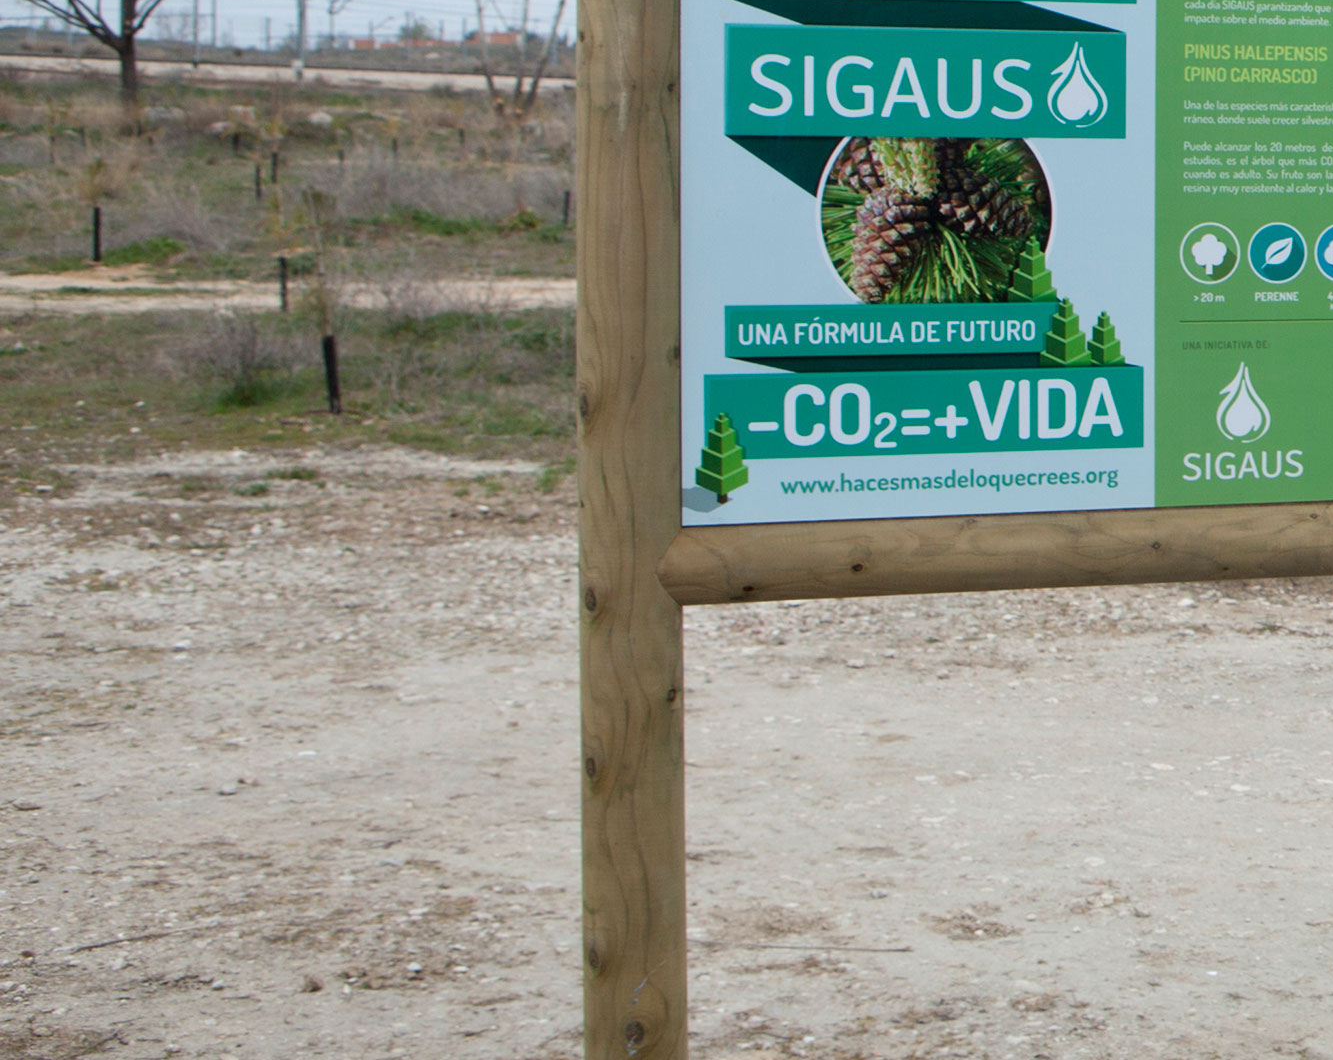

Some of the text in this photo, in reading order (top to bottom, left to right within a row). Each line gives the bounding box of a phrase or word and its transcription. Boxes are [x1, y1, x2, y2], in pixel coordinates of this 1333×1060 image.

[1184, 43, 1327, 61] PINUS HALEPENSIS
[1183, 65, 1317, 84] (PINO CARRASCO)
[748, 53, 1034, 120] SIGAUS
[1200, 293, 1214, 302] 20
[1215, 294, 1224, 302] m
[1254, 292, 1299, 302] PERENNE
[738, 317, 1036, 346] UNA FÓRMULA DE FUTURO
[1182, 340, 1202, 350] UNA
[1204, 340, 1254, 350] INICIATIVA
[1182, 449, 1304, 481] SIGAUS
[780, 468, 1119, 495] www.hacesmasdeloquecrees.org
